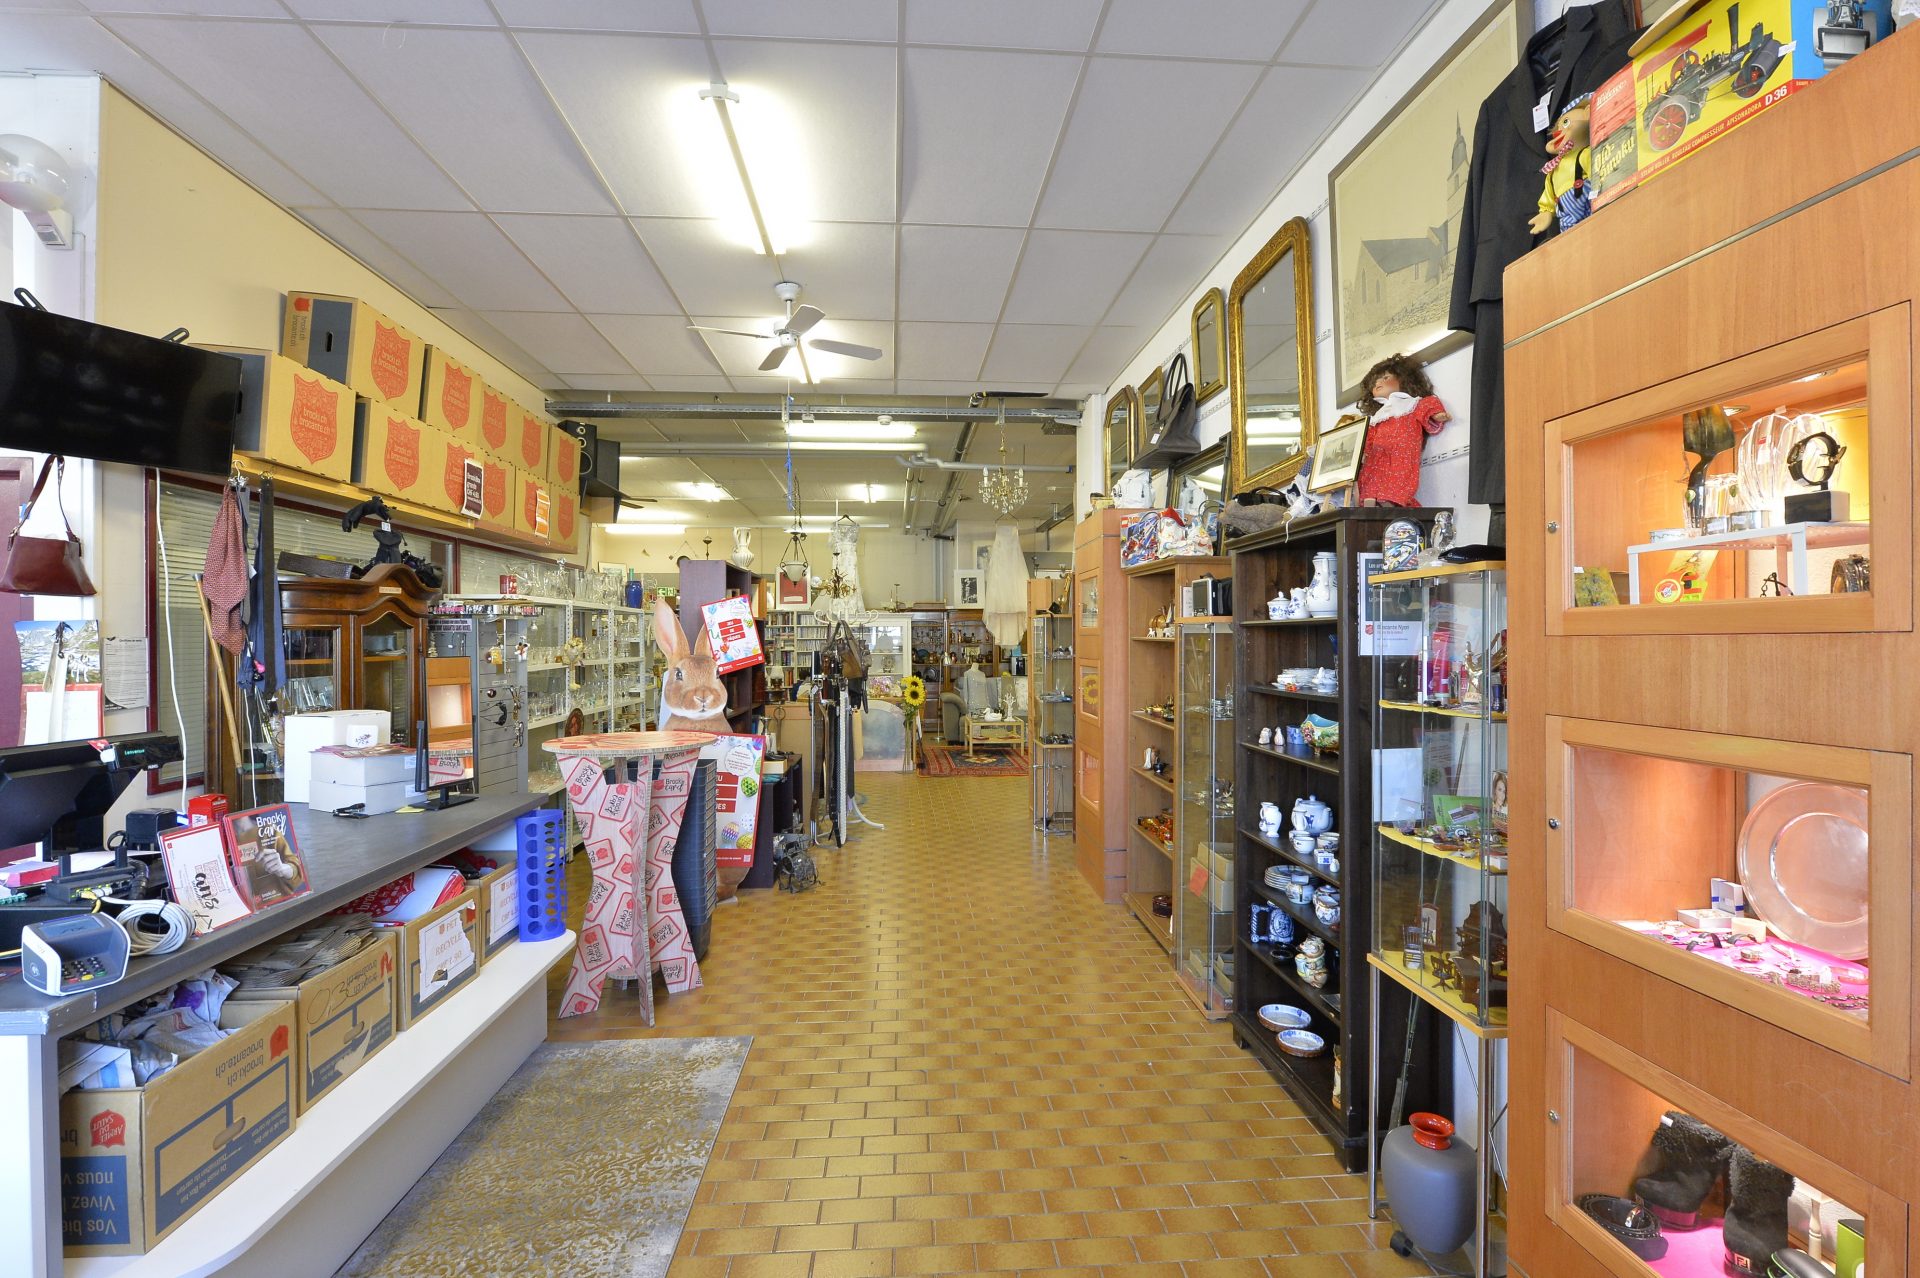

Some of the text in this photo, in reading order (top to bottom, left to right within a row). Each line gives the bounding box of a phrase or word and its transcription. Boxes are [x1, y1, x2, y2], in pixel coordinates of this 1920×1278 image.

[256, 812, 284, 828] Brocki
[258, 815, 287, 838] card
[435, 932, 462, 957] RECYCLE
[215, 1038, 264, 1078] brocante.ch
[227, 1054, 264, 1087] brocki.ch
[76, 1171, 113, 1186] nous
[71, 1195, 115, 1212] Vivez
[87, 1219, 117, 1235] Vos
